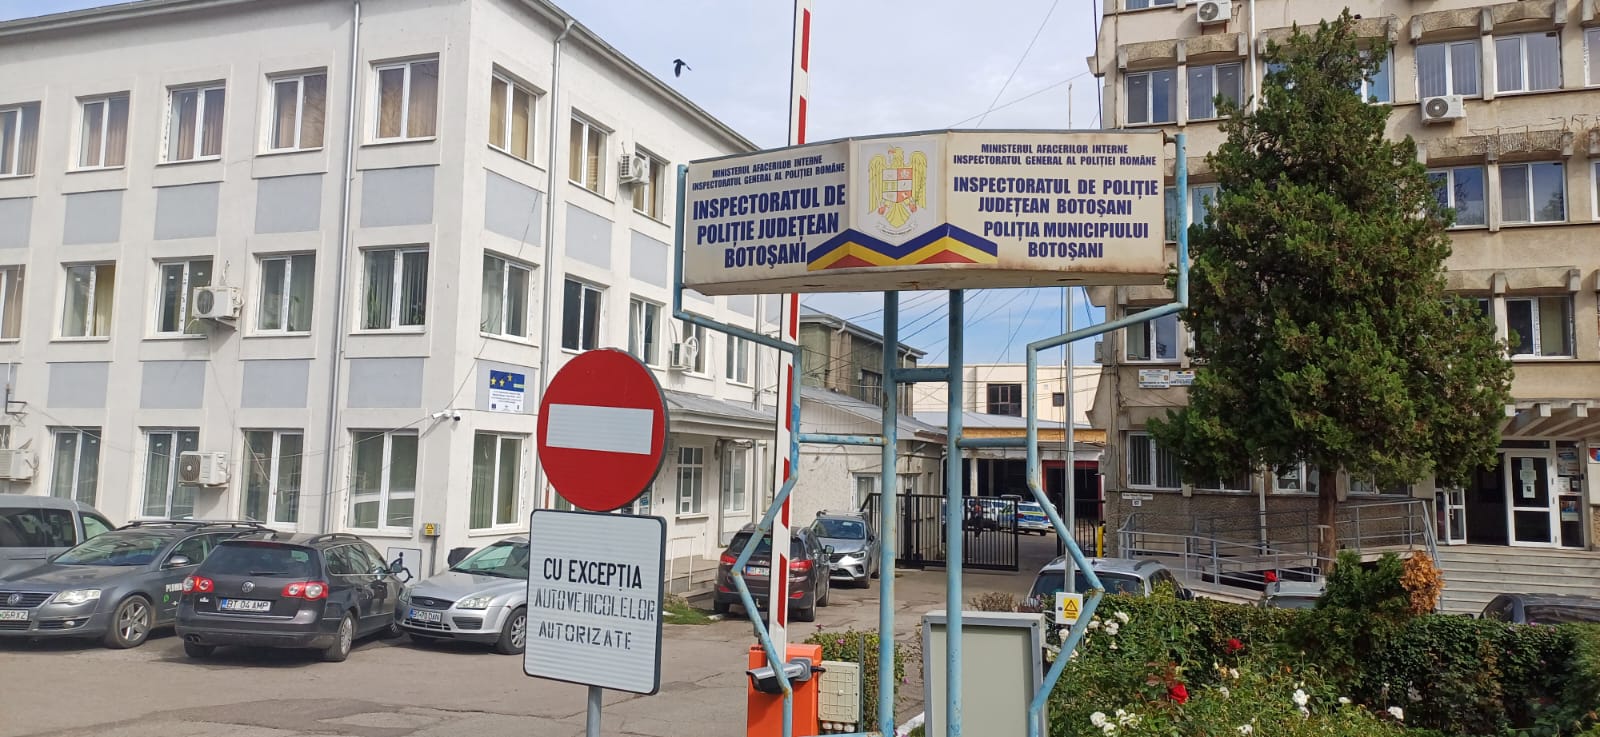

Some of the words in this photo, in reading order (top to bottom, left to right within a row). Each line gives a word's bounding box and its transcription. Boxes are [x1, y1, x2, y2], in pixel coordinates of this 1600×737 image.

[954, 155, 1022, 165] INSPECTORATUL
[1025, 156, 1062, 166] GENERAL
[1066, 156, 1076, 166] AL
[1080, 156, 1116, 168] POLIȚIEI
[1120, 155, 1156, 166] ROMÂNE
[981, 144, 1032, 154] MINISTERUL
[1036, 144, 1088, 154] AFACERILOR
[1092, 144, 1128, 154] INTERNE
[692, 178, 742, 191] INSPECTORATUL
[744, 174, 772, 185] GENERAL
[774, 172, 782, 181] AL
[785, 168, 812, 180] POLIȚIEI
[816, 162, 845, 175] ROMÂNE
[712, 166, 750, 178] MINISTERUL
[752, 160, 792, 172] AFACERILOR
[794, 155, 822, 167] INTERNE
[954, 176, 1070, 194] INSPECTORATUL
[1078, 180, 1096, 194] DE
[1103, 180, 1158, 199] POLIȚIE
[693, 188, 820, 220] INSPECTORATUL
[824, 184, 846, 206] DE
[978, 197, 1050, 217] JUDEȚEAN
[697, 220, 754, 247] POLIȚIE
[758, 212, 839, 241] JUDEȚEAN
[984, 221, 1040, 241] POLIȚIA
[1044, 222, 1148, 238] MUNICIPIULUI
[544, 558, 562, 581] CU
[568, 560, 642, 591] EXCEPȚIA
[535, 588, 656, 622] AUTOVEHICOLELOR
[538, 620, 632, 650] AUTORIZATE
